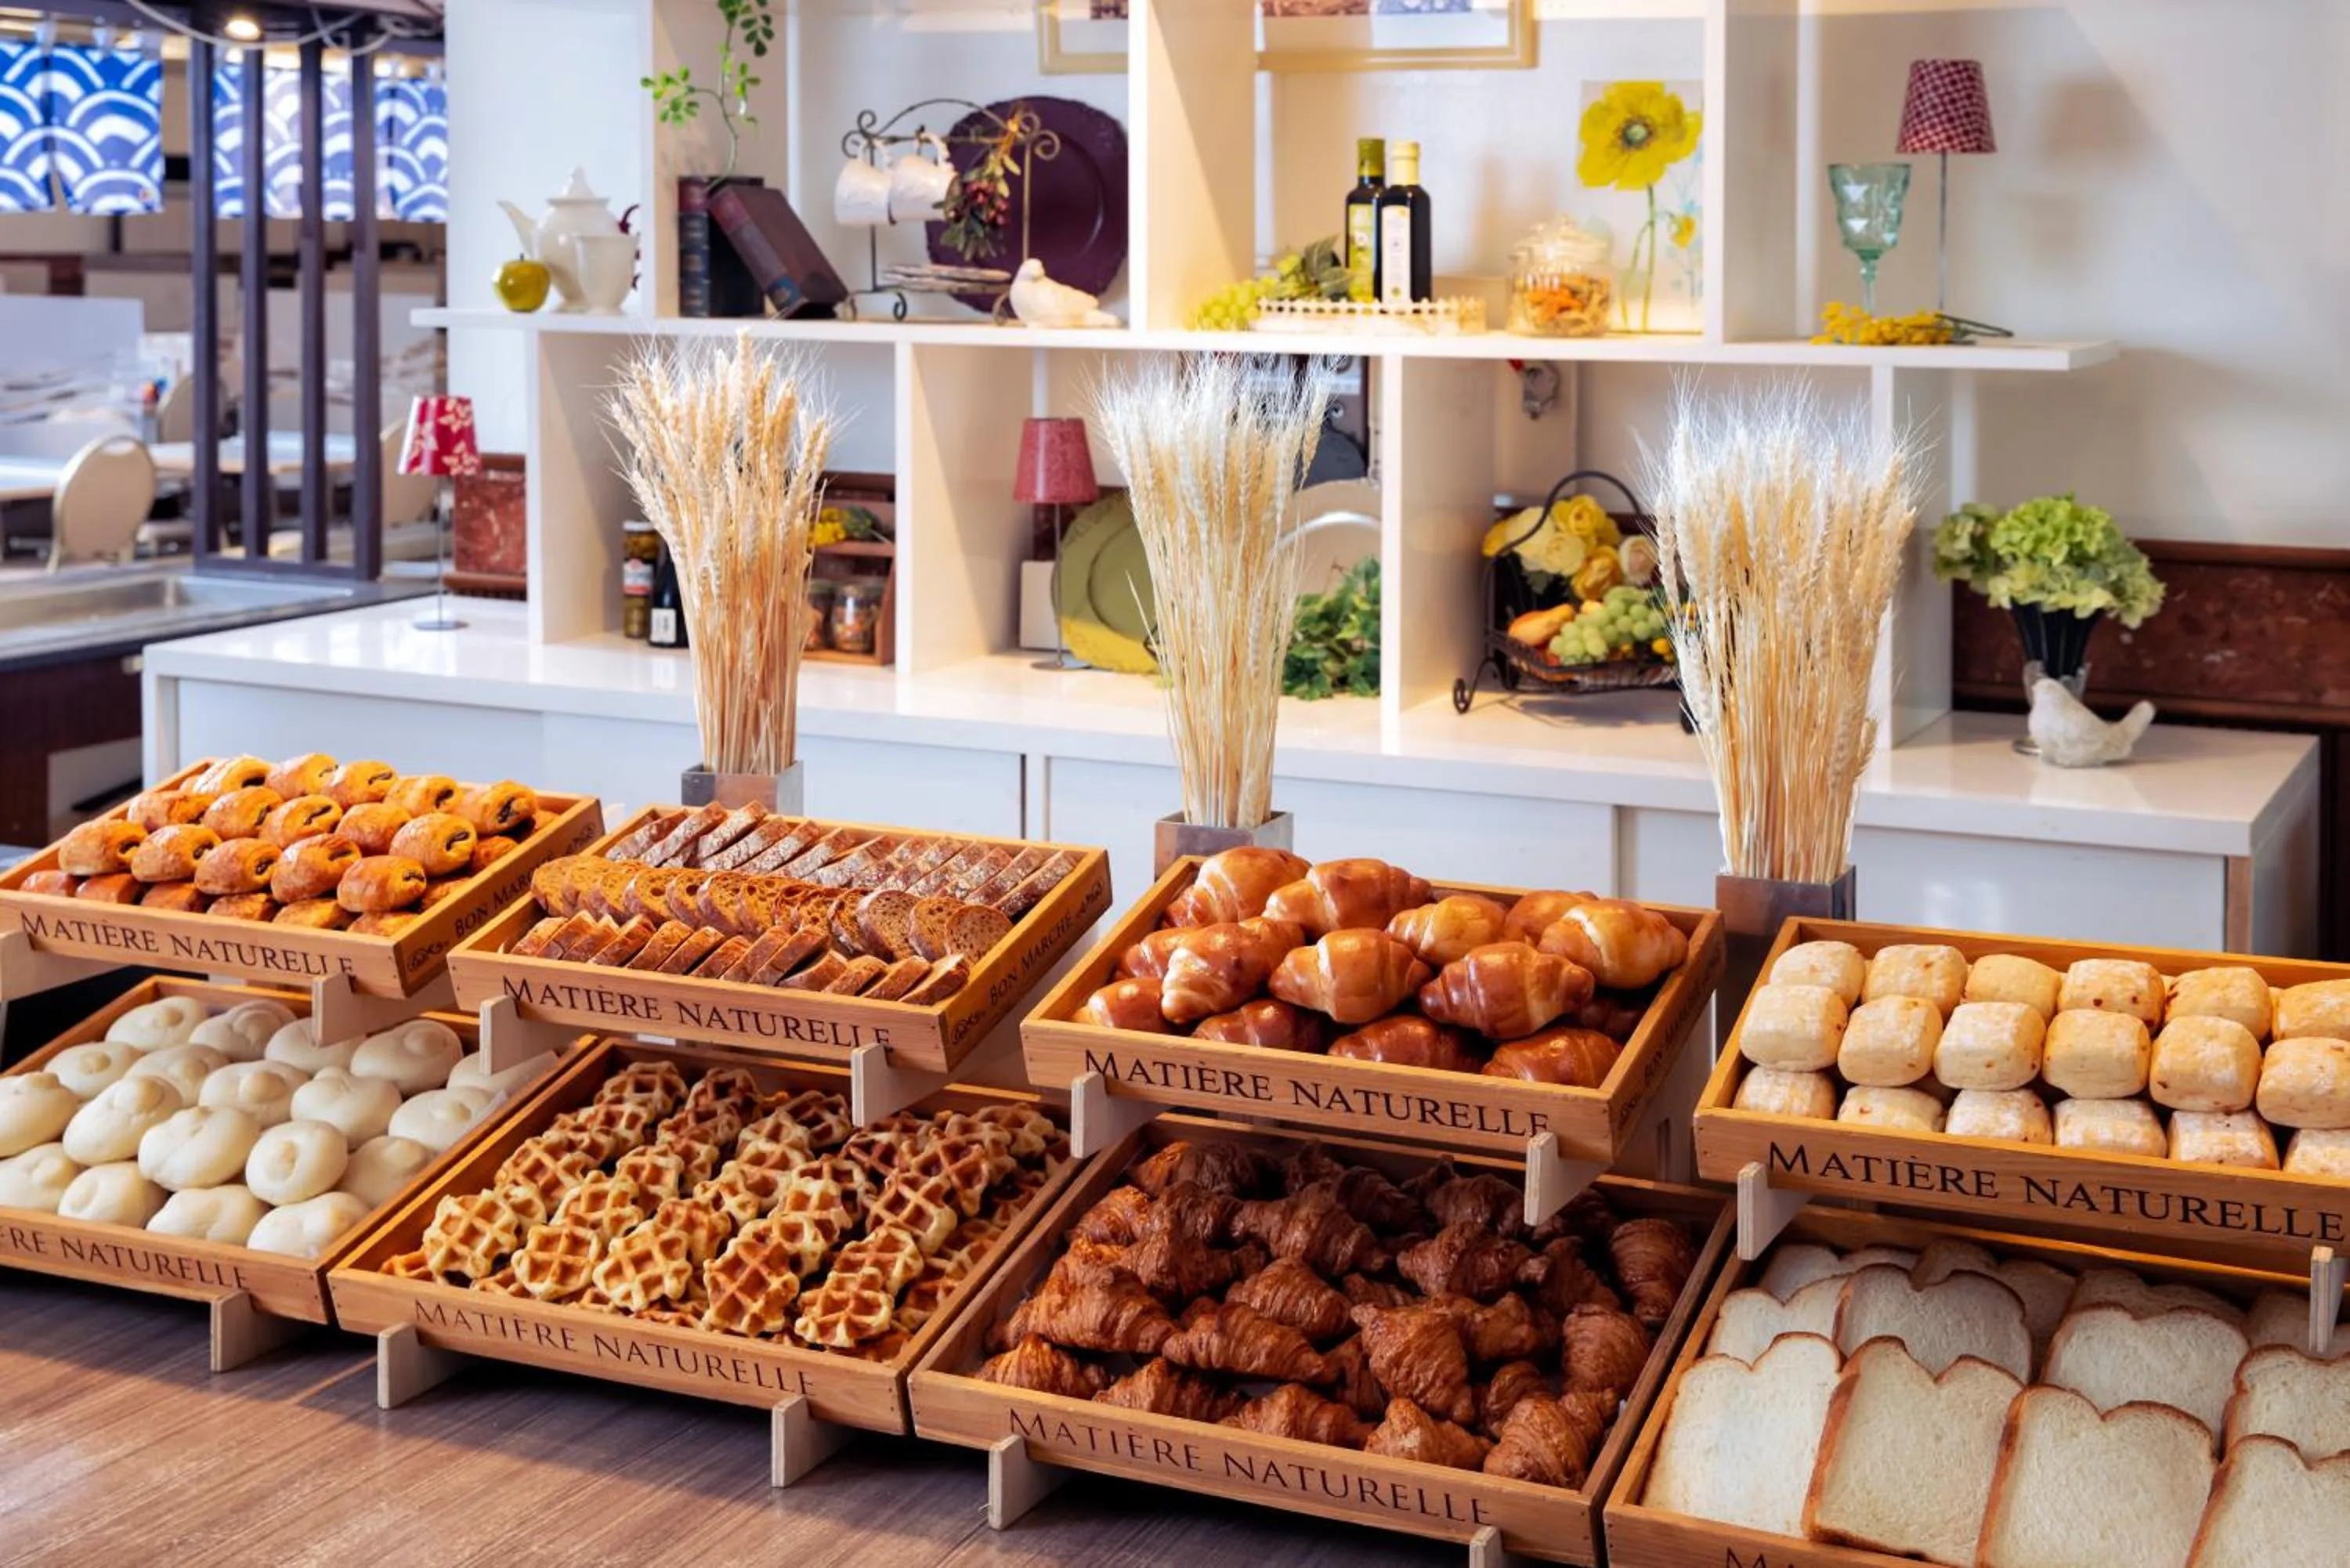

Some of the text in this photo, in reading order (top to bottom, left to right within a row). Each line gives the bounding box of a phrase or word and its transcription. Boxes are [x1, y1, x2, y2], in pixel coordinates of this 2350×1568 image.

[21, 912, 159, 953] MATIÈRE
[454, 902, 489, 938] BON
[502, 975, 895, 1053] MATIÈRE NATURELLE
[1085, 1049, 1549, 1137] MATIÈRE NATURELLE
[1769, 1141, 2345, 1242] MATIÈRE NATURELLE
[60, 1236, 250, 1291] NATURELLE
[594, 1334, 815, 1396] NATURELLE
[1010, 1408, 1492, 1526] MATIÈRE NATURELLE
